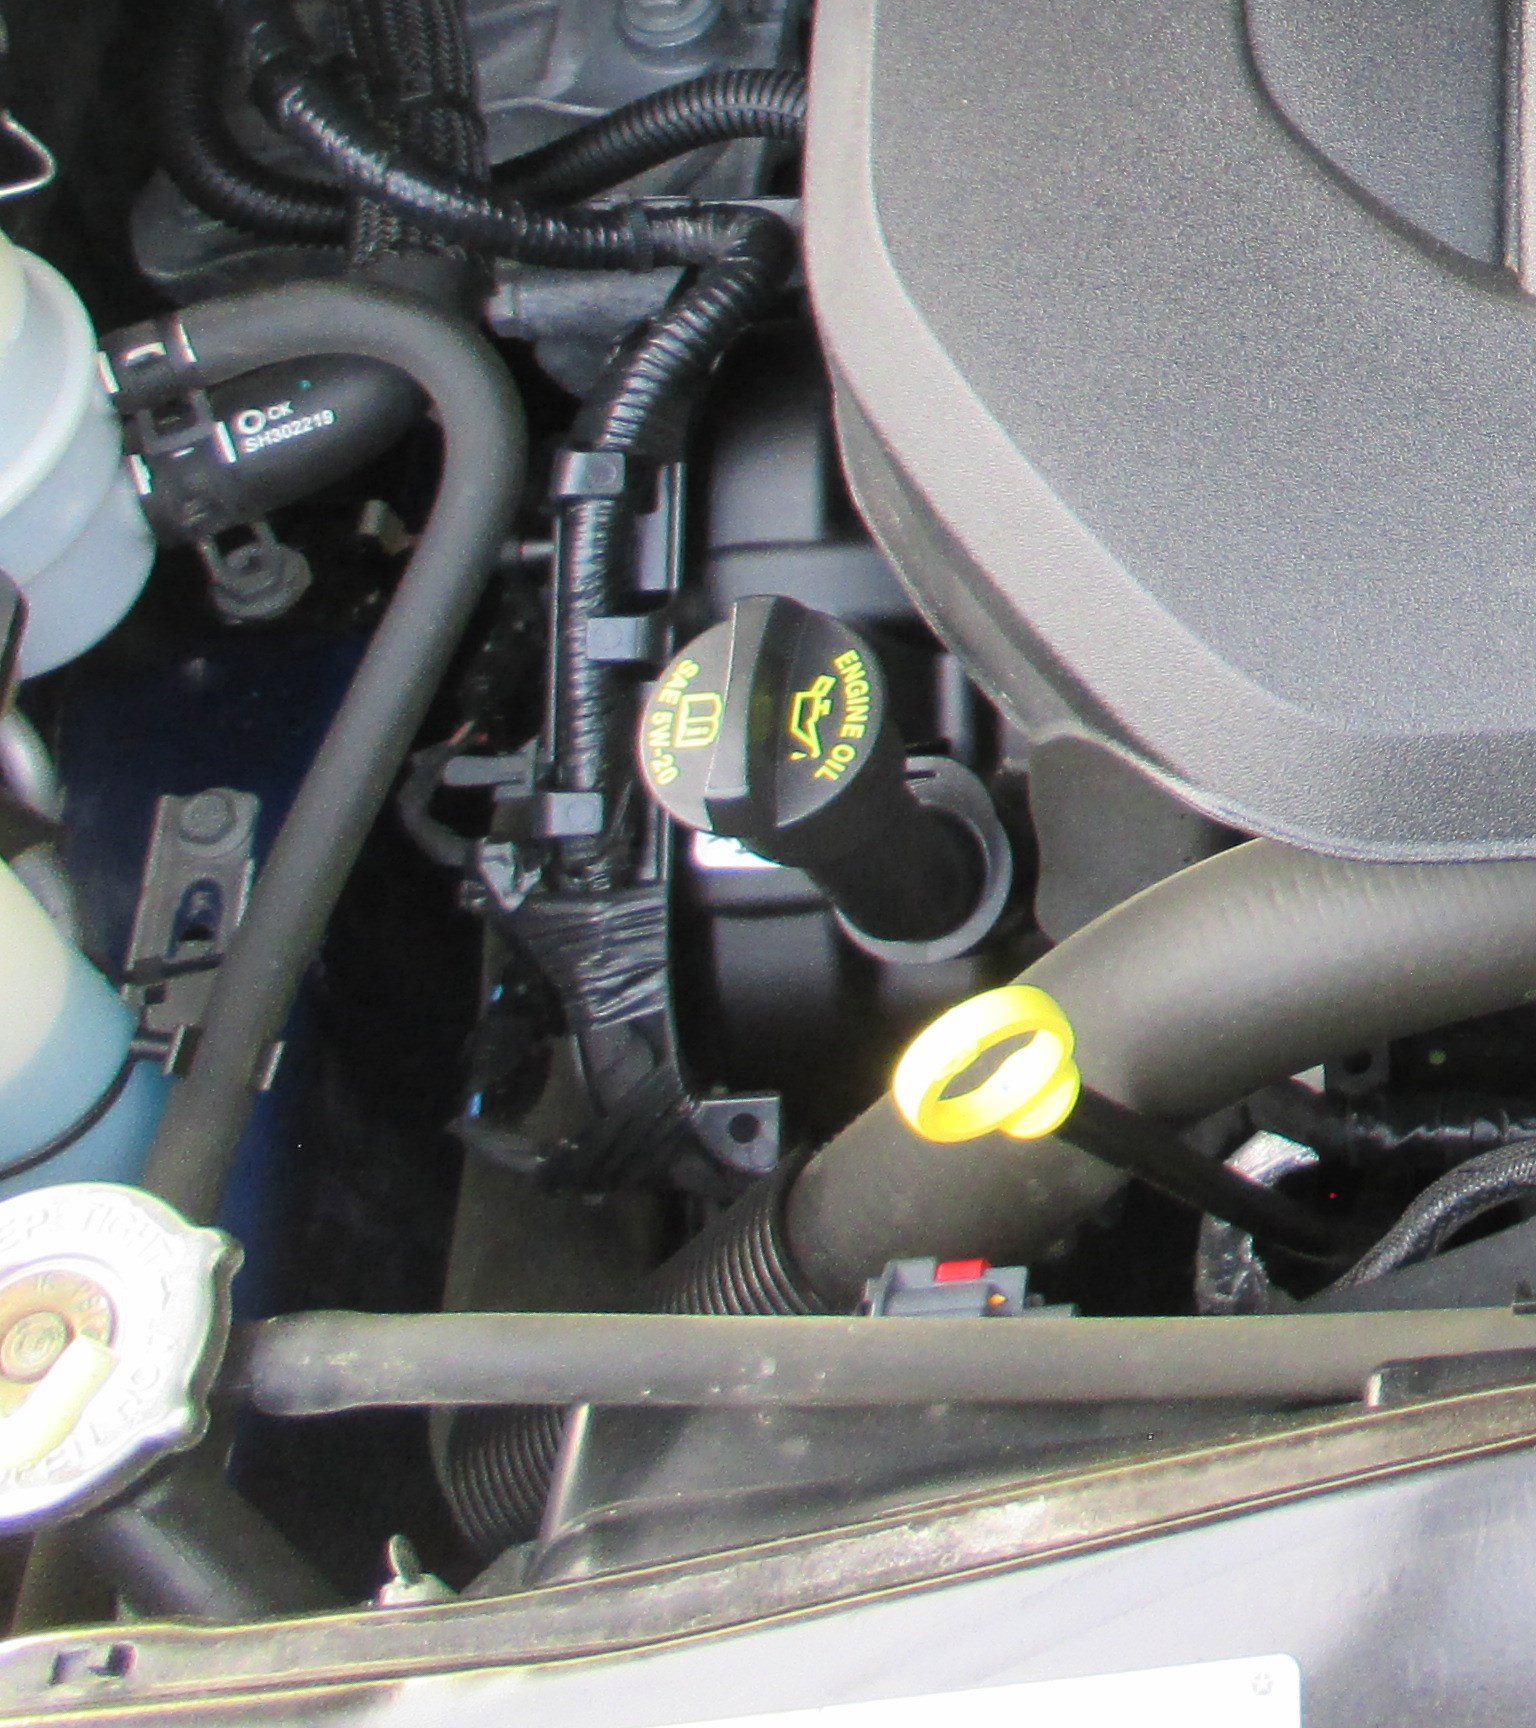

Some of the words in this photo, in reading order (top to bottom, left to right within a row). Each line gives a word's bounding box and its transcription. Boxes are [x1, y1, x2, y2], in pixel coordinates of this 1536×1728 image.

[658, 657, 704, 707] SAE
[832, 647, 873, 740] ENGINE
[646, 711, 682, 787] 5W-20
[814, 742, 858, 782] OIL
